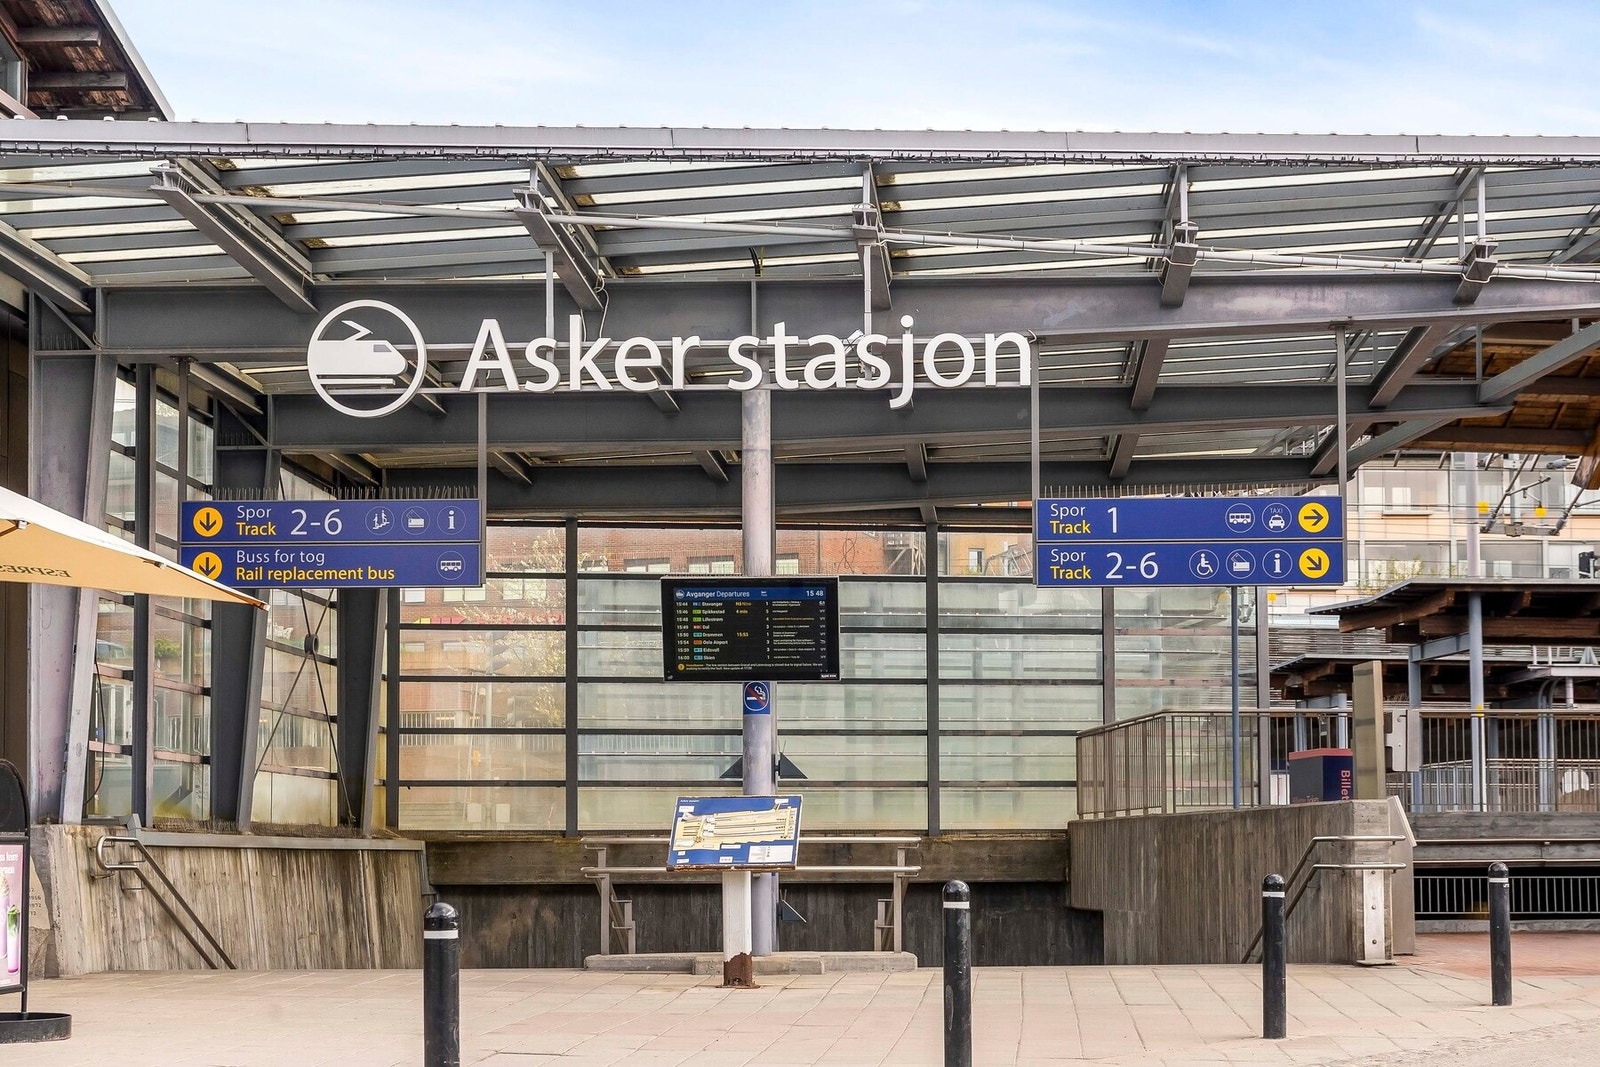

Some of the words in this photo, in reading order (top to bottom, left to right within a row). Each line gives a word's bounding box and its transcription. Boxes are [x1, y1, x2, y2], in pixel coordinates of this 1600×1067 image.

[459, 314, 701, 393] Asker
[728, 314, 1032, 410] stasjon
[236, 505, 271, 520] Spor
[1050, 503, 1086, 519] Spor
[290, 508, 343, 536] 2-6
[1049, 520, 1092, 535] Track
[1107, 506, 1119, 533] 1
[236, 522, 277, 537] Track
[236, 550, 270, 564] Buss
[274, 550, 295, 564] for
[299, 552, 325, 567] tog
[1050, 548, 1086, 564] Spor
[1050, 565, 1092, 580] Track
[1105, 551, 1159, 580] 2-6
[236, 567, 263, 581] Rail
[268, 567, 363, 584] replacement
[368, 567, 395, 581] bus
[686, 591, 715, 599] Avganger
[716, 590, 750, 598] Departures
